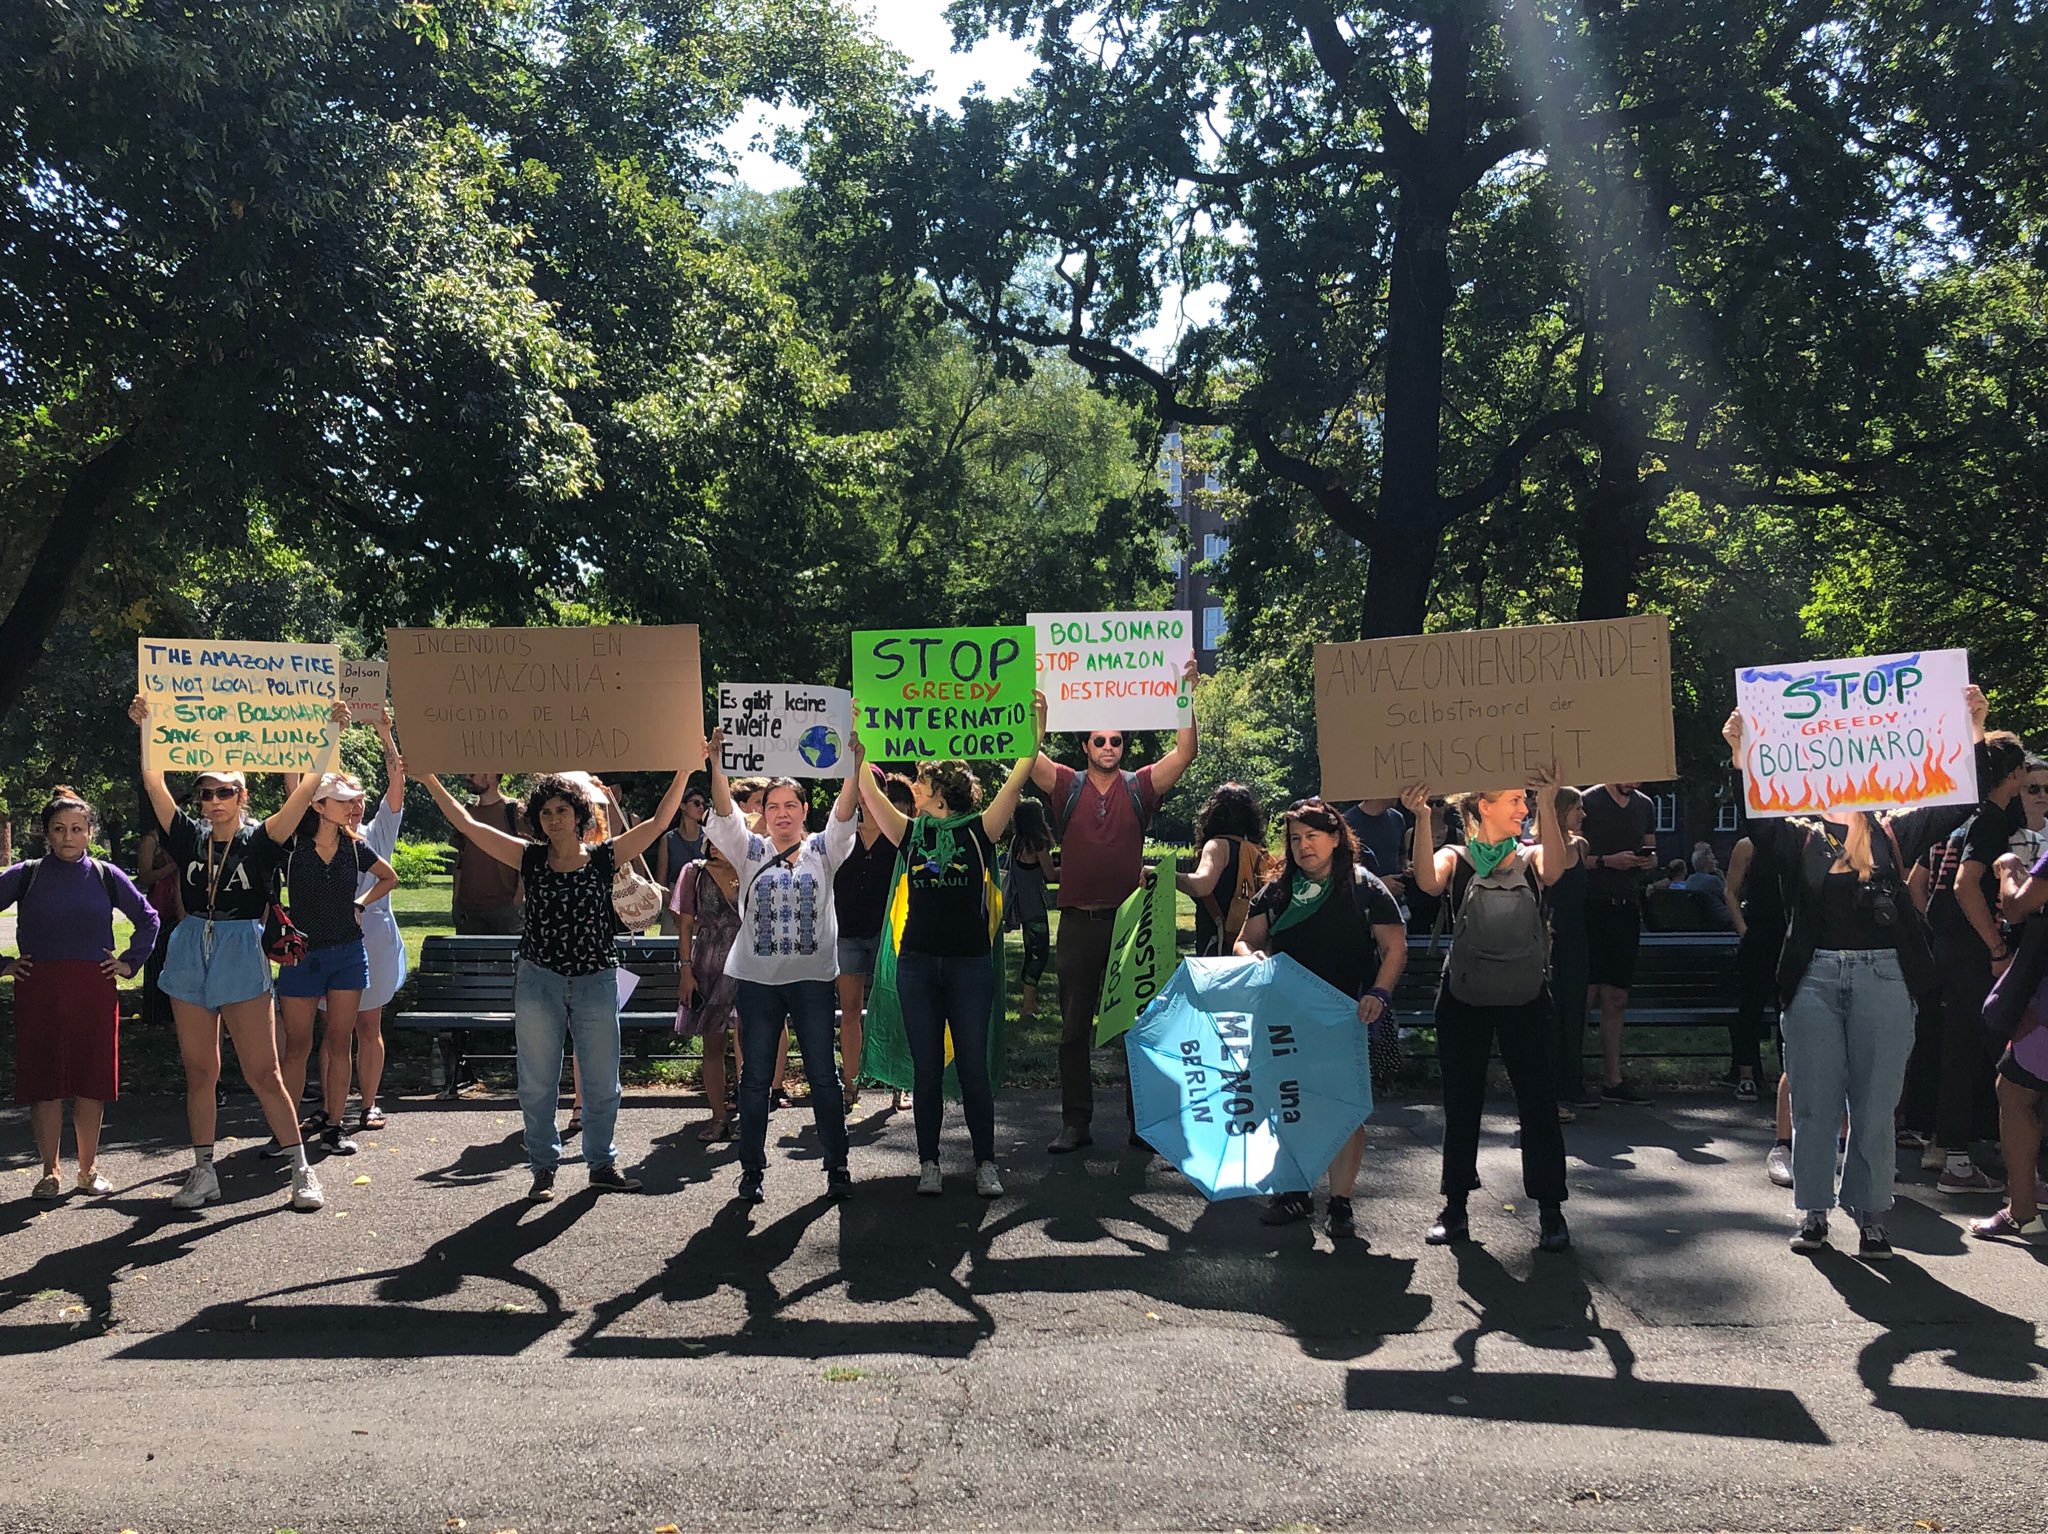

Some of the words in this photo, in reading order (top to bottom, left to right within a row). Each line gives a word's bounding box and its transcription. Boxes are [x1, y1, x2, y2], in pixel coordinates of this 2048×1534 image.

[412, 633, 533, 657] INCENDIOS
[592, 632, 623, 657] EN
[1050, 619, 1184, 645] BOLSONARO
[144, 644, 192, 665] THE
[200, 649, 285, 671] AMAZON
[290, 655, 336, 676] FIRE
[873, 638, 1021, 682] STOP
[1036, 651, 1079, 672] STOP
[1086, 650, 1164, 672] AMAZON
[1325, 622, 1658, 697] AMAZONIENBRÄNDE:
[145, 673, 164, 691] IS
[172, 676, 204, 694] NOT
[212, 677, 257, 694] LOCAL
[266, 677, 336, 699] POLITICS
[902, 680, 1002, 703] GREEDY
[1061, 675, 1189, 708] DESTRUCTION!
[1783, 665, 1923, 719] STOP
[174, 703, 229, 723] STOP
[533, 705, 552, 722] DE
[571, 705, 591, 722] LA
[720, 689, 738, 709] Es
[742, 689, 773, 719] gibt
[785, 690, 827, 712] keine
[1384, 696, 1529, 727] Selbstmord
[1550, 695, 1574, 711] der
[153, 725, 202, 744] SAVE
[214, 731, 255, 744] OUR
[262, 727, 329, 748] LUNGS
[722, 712, 782, 738] zweite
[1801, 710, 1899, 736] GREEDY
[169, 747, 215, 767] END
[461, 727, 631, 760] HUMANIDAD
[721, 743, 765, 771] Erde
[884, 736, 936, 757] NAL
[950, 731, 1015, 757] CORP.
[1759, 728, 1925, 777] BOLSONARO
[1267, 1025, 1298, 1057] Ni
[1179, 1039, 1214, 1123] BERLIN
[1215, 1015, 1257, 1137] MENOS
[1279, 1079, 1302, 1124] una
